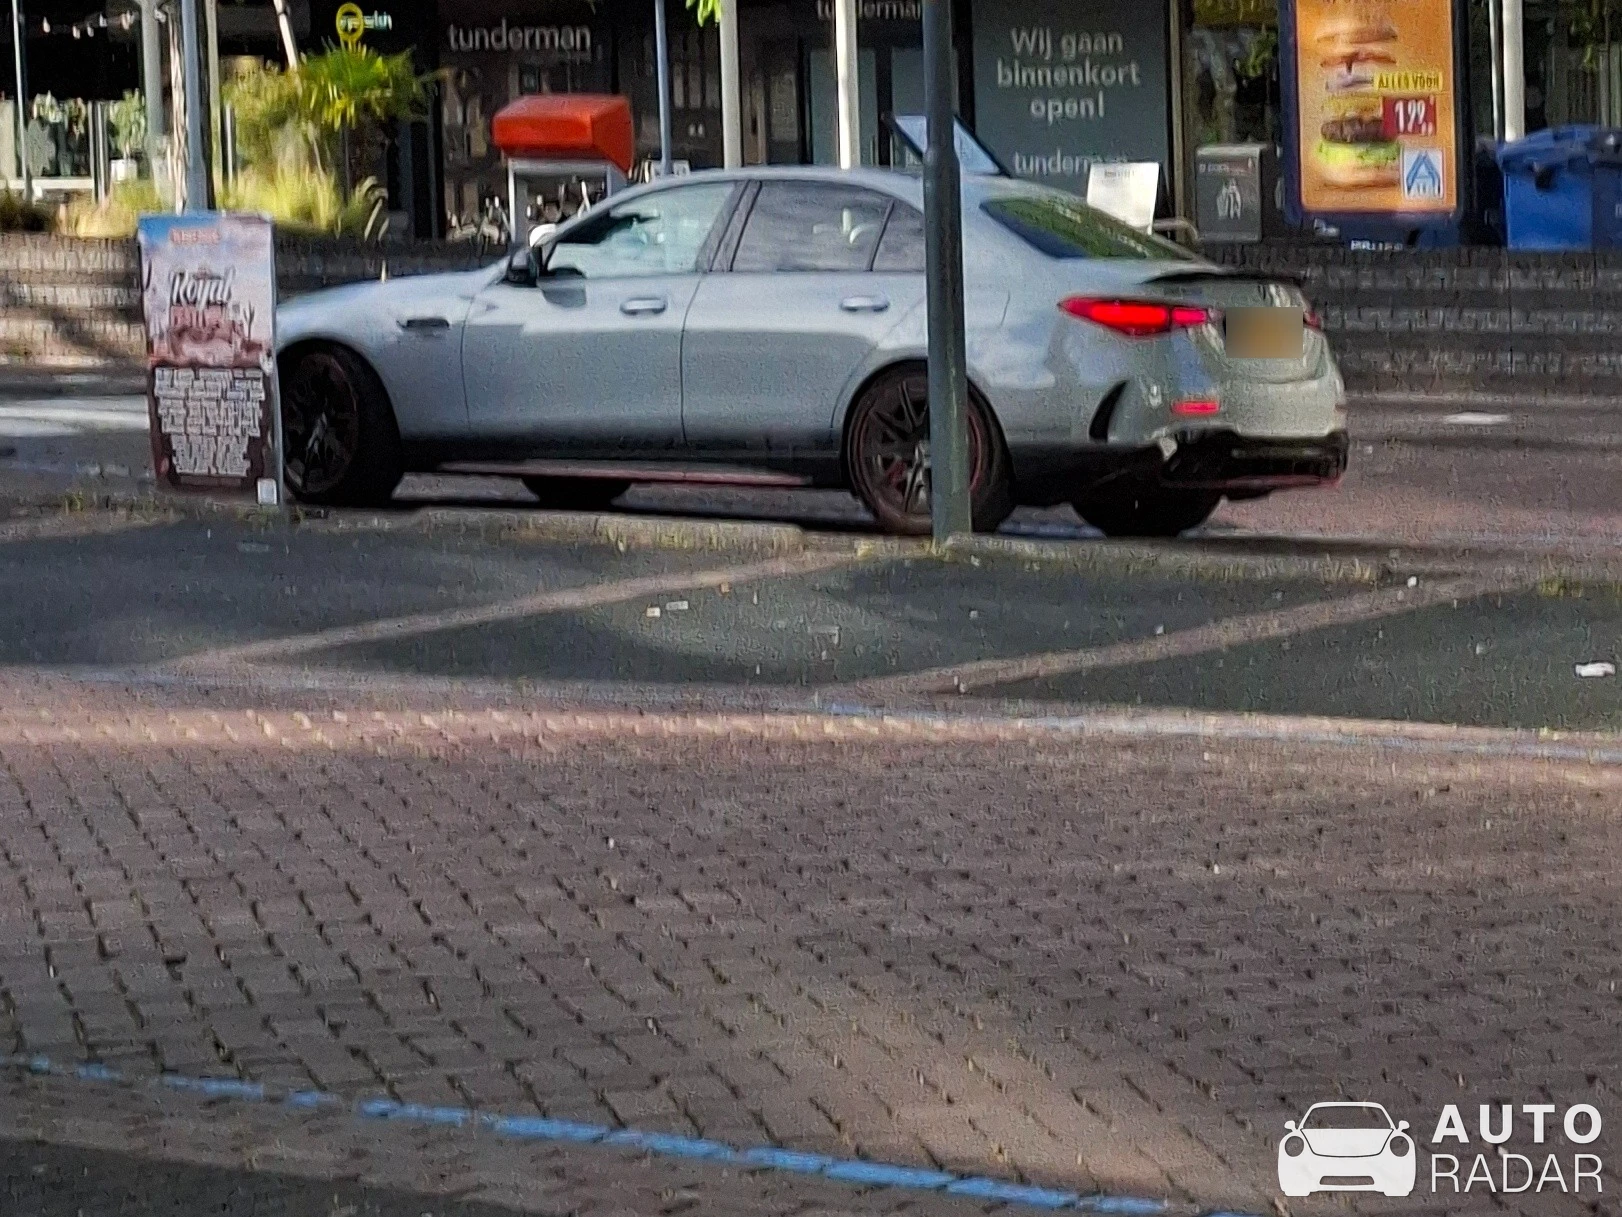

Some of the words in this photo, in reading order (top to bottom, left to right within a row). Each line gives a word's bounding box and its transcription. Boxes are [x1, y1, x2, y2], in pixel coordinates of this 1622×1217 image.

[448, 18, 591, 51] tunderman
[1010, 26, 1052, 61] Wij
[1061, 31, 1123, 60] gaan
[997, 57, 1140, 87] binnenkort
